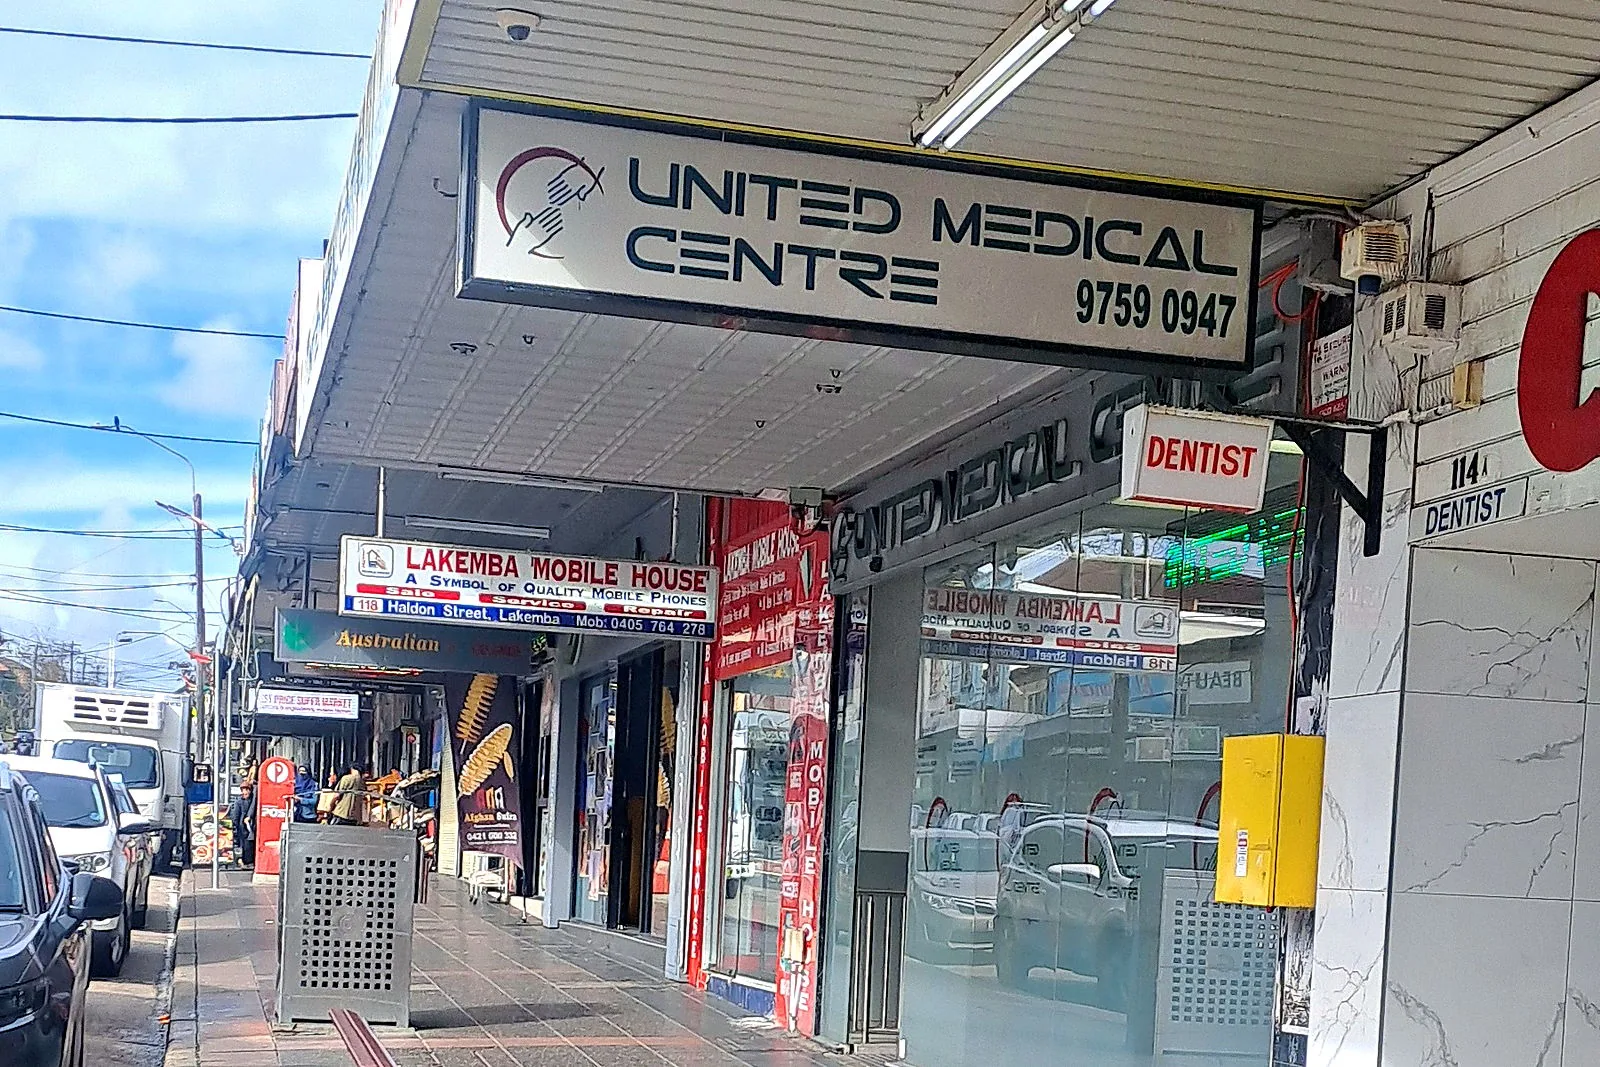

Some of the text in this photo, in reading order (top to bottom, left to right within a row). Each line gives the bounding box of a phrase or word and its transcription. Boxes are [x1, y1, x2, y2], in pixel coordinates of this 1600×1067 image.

[628, 157, 1238, 277] UNITED MEDICAL
[626, 226, 940, 305] CENTRE
[1076, 278, 1237, 338] 9759 0947
[944, 418, 1083, 524] MEDICAL
[1146, 435, 1258, 478] DENTIST
[1425, 487, 1506, 536] DENTIST
[406, 546, 519, 578] LAKEMBA
[386, 586, 694, 617] Sale Service Repair
[405, 573, 707, 606] A SYMBOL OF QUALITY MOBILE PHONES
[335, 627, 440, 652] Australian
[357, 599, 379, 611] 118
[387, 599, 435, 616] Haldon
[499, 609, 561, 625] Lakemba
[610, 617, 643, 632] 0405
[651, 620, 674, 634] 764
[682, 622, 706, 636] 278
[804, 740, 823, 875] MOBILE
